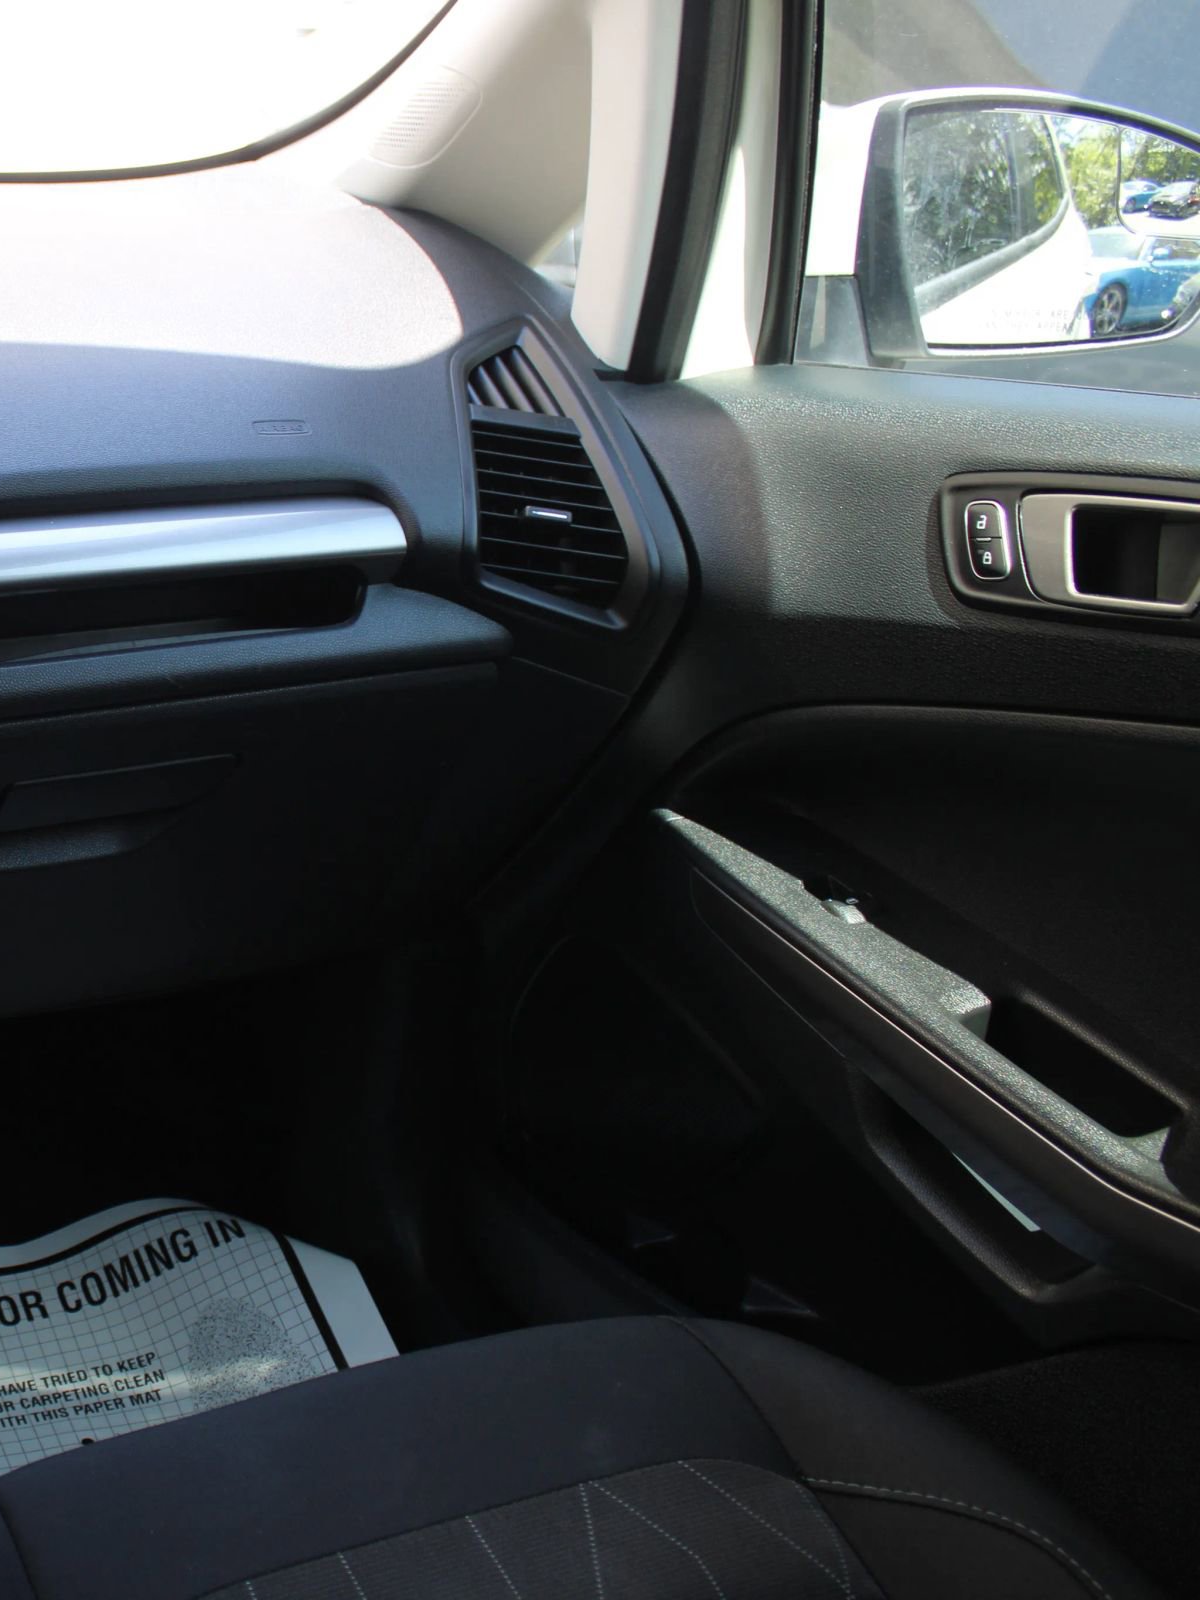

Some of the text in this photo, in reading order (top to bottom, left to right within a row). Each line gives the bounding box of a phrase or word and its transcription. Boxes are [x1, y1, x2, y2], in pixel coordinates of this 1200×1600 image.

[56, 1227, 199, 1315] COMING
[206, 1216, 247, 1249] IN
[21, 1383, 109, 1409] CARPETING
[114, 1369, 165, 1391] CLEAN
[40, 1370, 88, 1388] TRIED
[92, 1364, 113, 1378] TO
[117, 1352, 156, 1372] KEEP
[32, 1407, 69, 1423] THIS
[74, 1397, 125, 1416] PAPER
[129, 1389, 162, 1406] MAT
